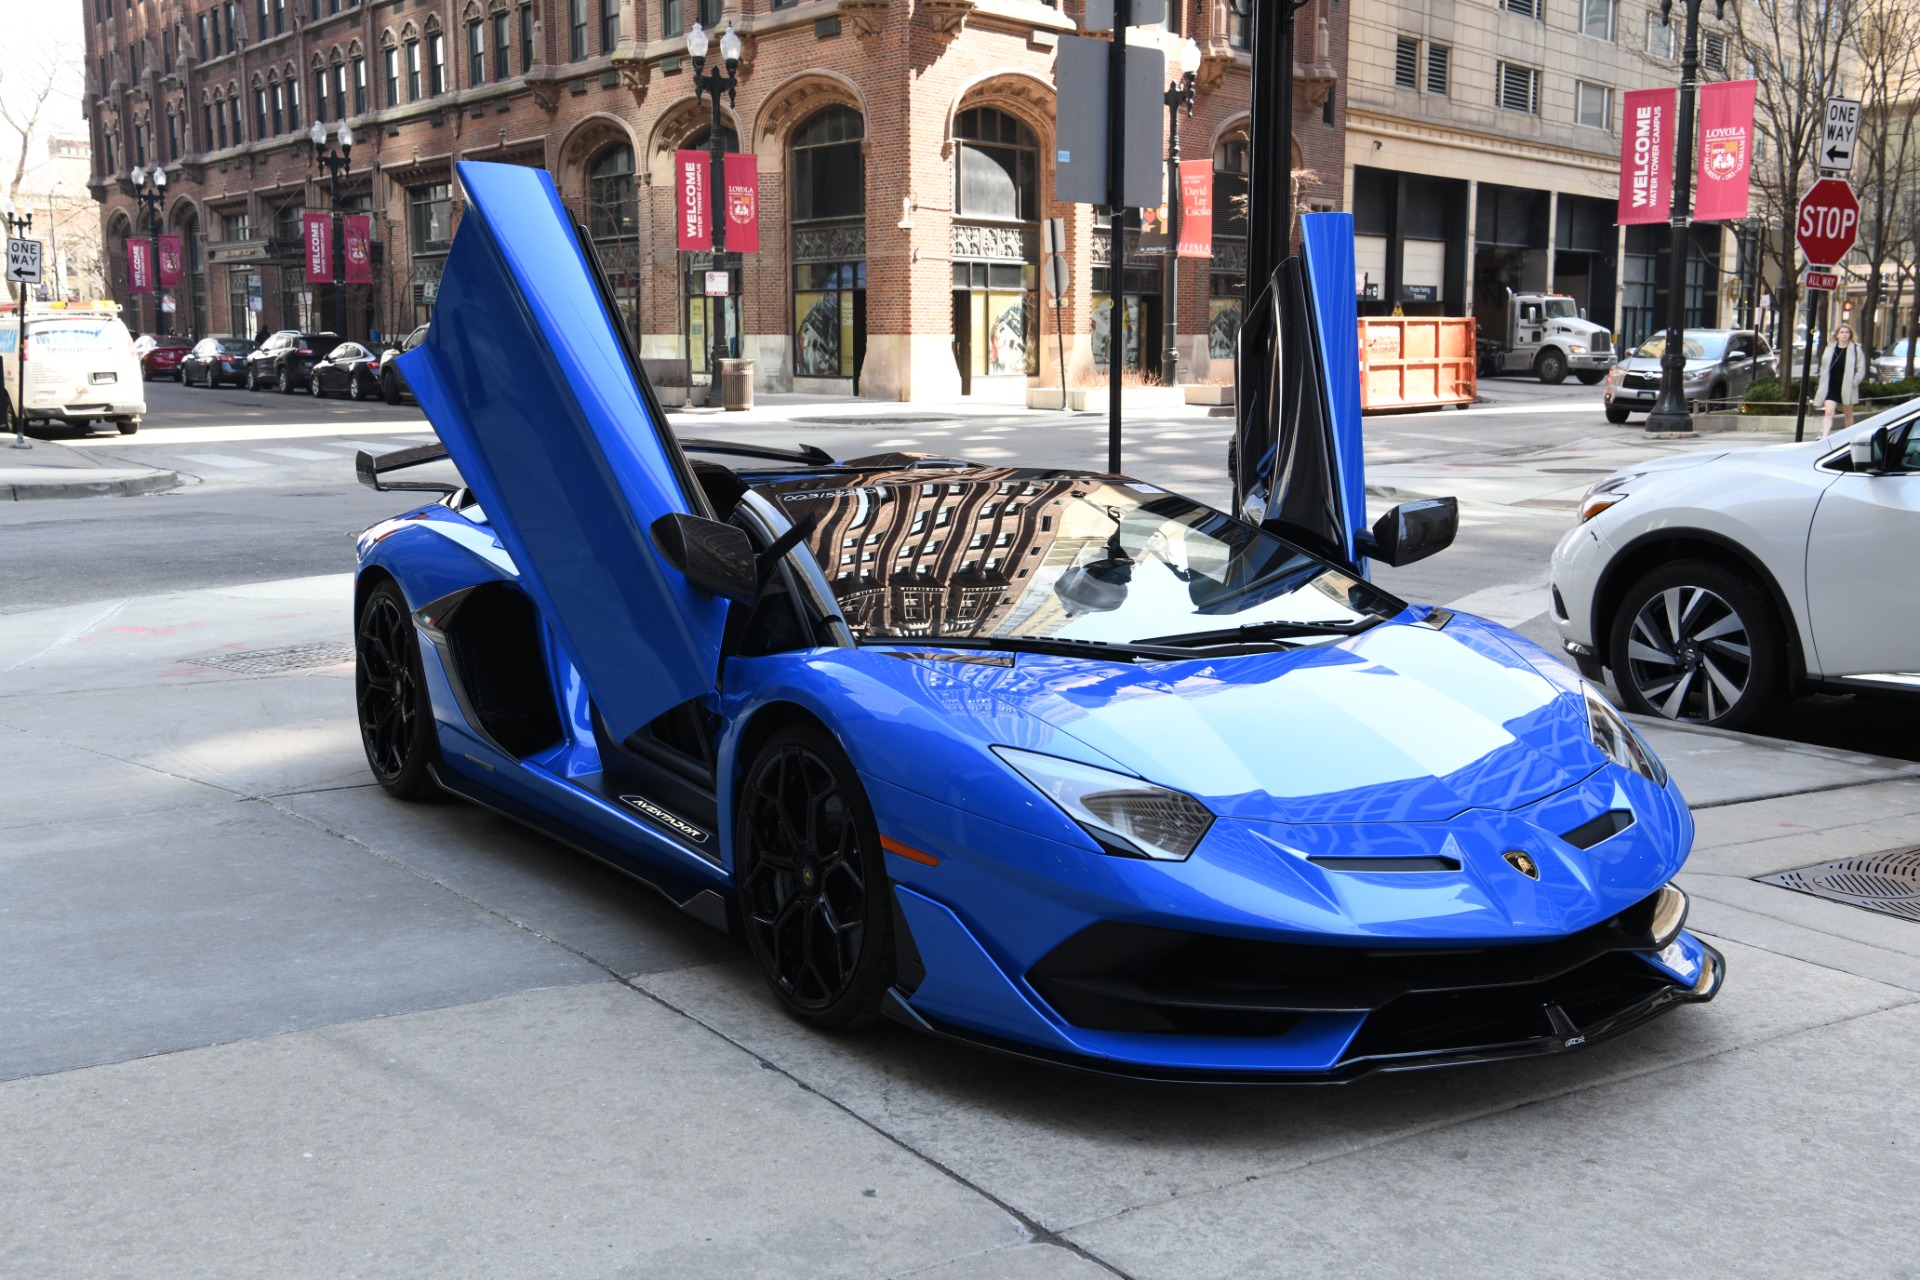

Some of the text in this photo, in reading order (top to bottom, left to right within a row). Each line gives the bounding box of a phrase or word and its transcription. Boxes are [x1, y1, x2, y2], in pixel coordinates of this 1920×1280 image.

[1829, 104, 1856, 123] ONE
[1705, 126, 1746, 138] LOYOLA
[1827, 124, 1854, 142] WAY
[1632, 106, 1652, 208] WELCOME
[1649, 106, 1661, 207] WATER TOWER CAMPUS
[1185, 185, 1207, 196] David
[685, 162, 697, 238] WELCOME
[1194, 196, 1207, 206] Lee
[1800, 205, 1856, 239] STOP
[11, 242, 37, 254] ONE
[310, 222, 320, 274] WELCOME
[1177, 242, 1211, 254] LUMA
[11, 254, 37, 266] WAY
[133, 245, 142, 287] WELCOME
[1808, 275, 1835, 288] ALL WAY
[632, 800, 702, 837] AVENTADOR
